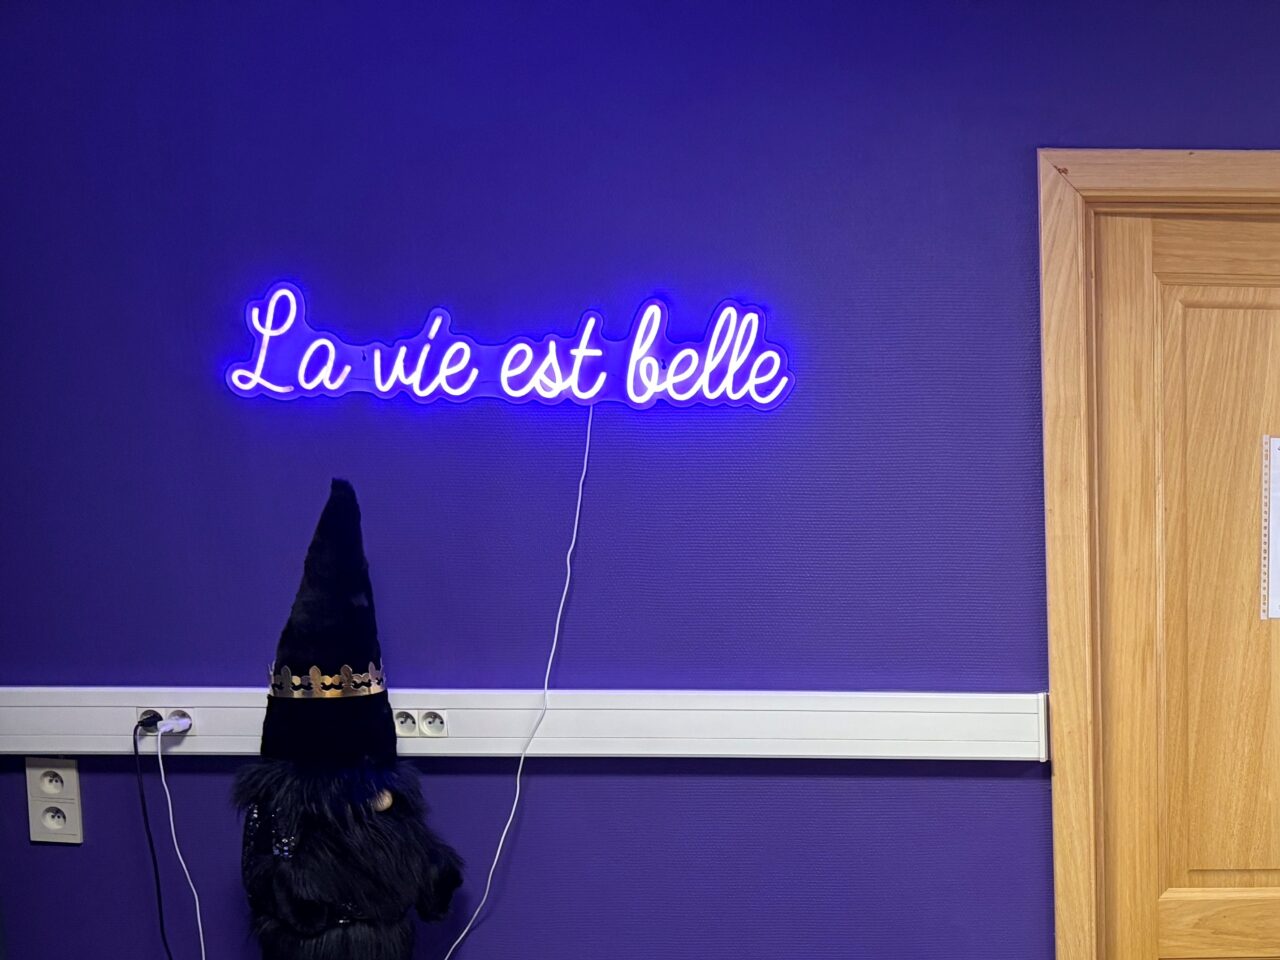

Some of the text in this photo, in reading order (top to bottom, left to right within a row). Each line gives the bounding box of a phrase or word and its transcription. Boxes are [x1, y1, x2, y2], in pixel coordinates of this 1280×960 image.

[230, 286, 789, 405] La vie est belle
